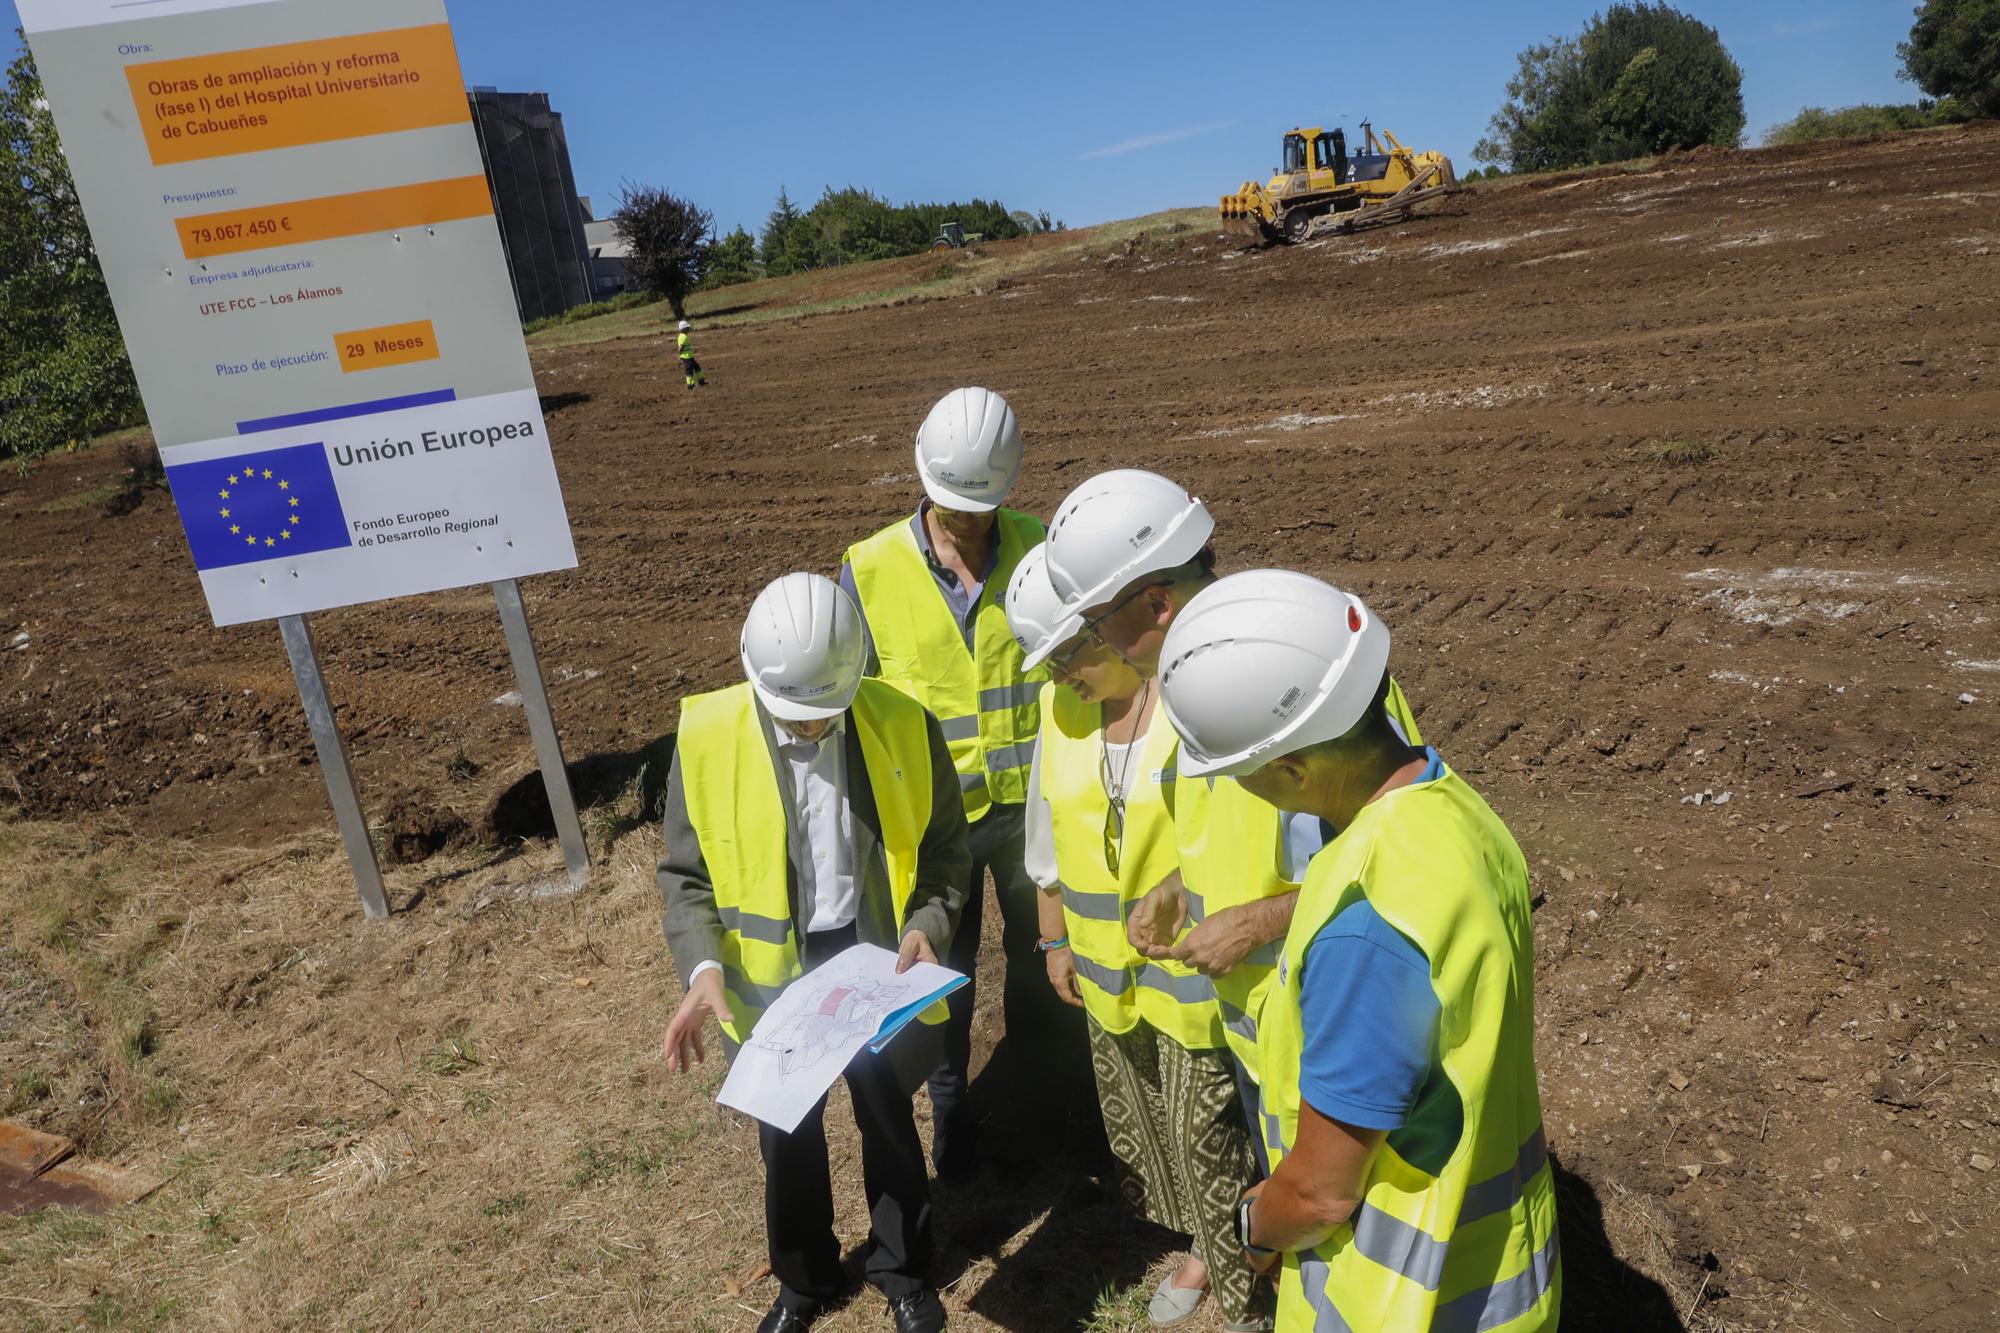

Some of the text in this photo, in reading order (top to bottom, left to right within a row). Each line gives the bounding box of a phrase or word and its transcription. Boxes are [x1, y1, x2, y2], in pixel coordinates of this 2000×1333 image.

[117, 43, 153, 55] Obra:
[148, 51, 400, 96] Obras de ampliación y reforma
[155, 69, 420, 121] (fase I) del Hospital Universitario
[161, 113, 268, 140] de Cabueñes
[162, 187, 238, 205] Presupuesto:
[191, 216, 292, 245] 79.067.450 €
[189, 259, 315, 286] Empresa adjudicataria:
[199, 301, 227, 316] UTE
[228, 297, 257, 311] FCC
[269, 294, 294, 305] Los
[297, 286, 343, 301] Álamos
[346, 337, 424, 359] 29 Meses
[215, 350, 329, 377] Plazo de ejecución:
[333, 421, 534, 467] Unión Europea
[353, 508, 450, 532] Fondo Europeo
[358, 514, 499, 548] de Desarrollo Regional
